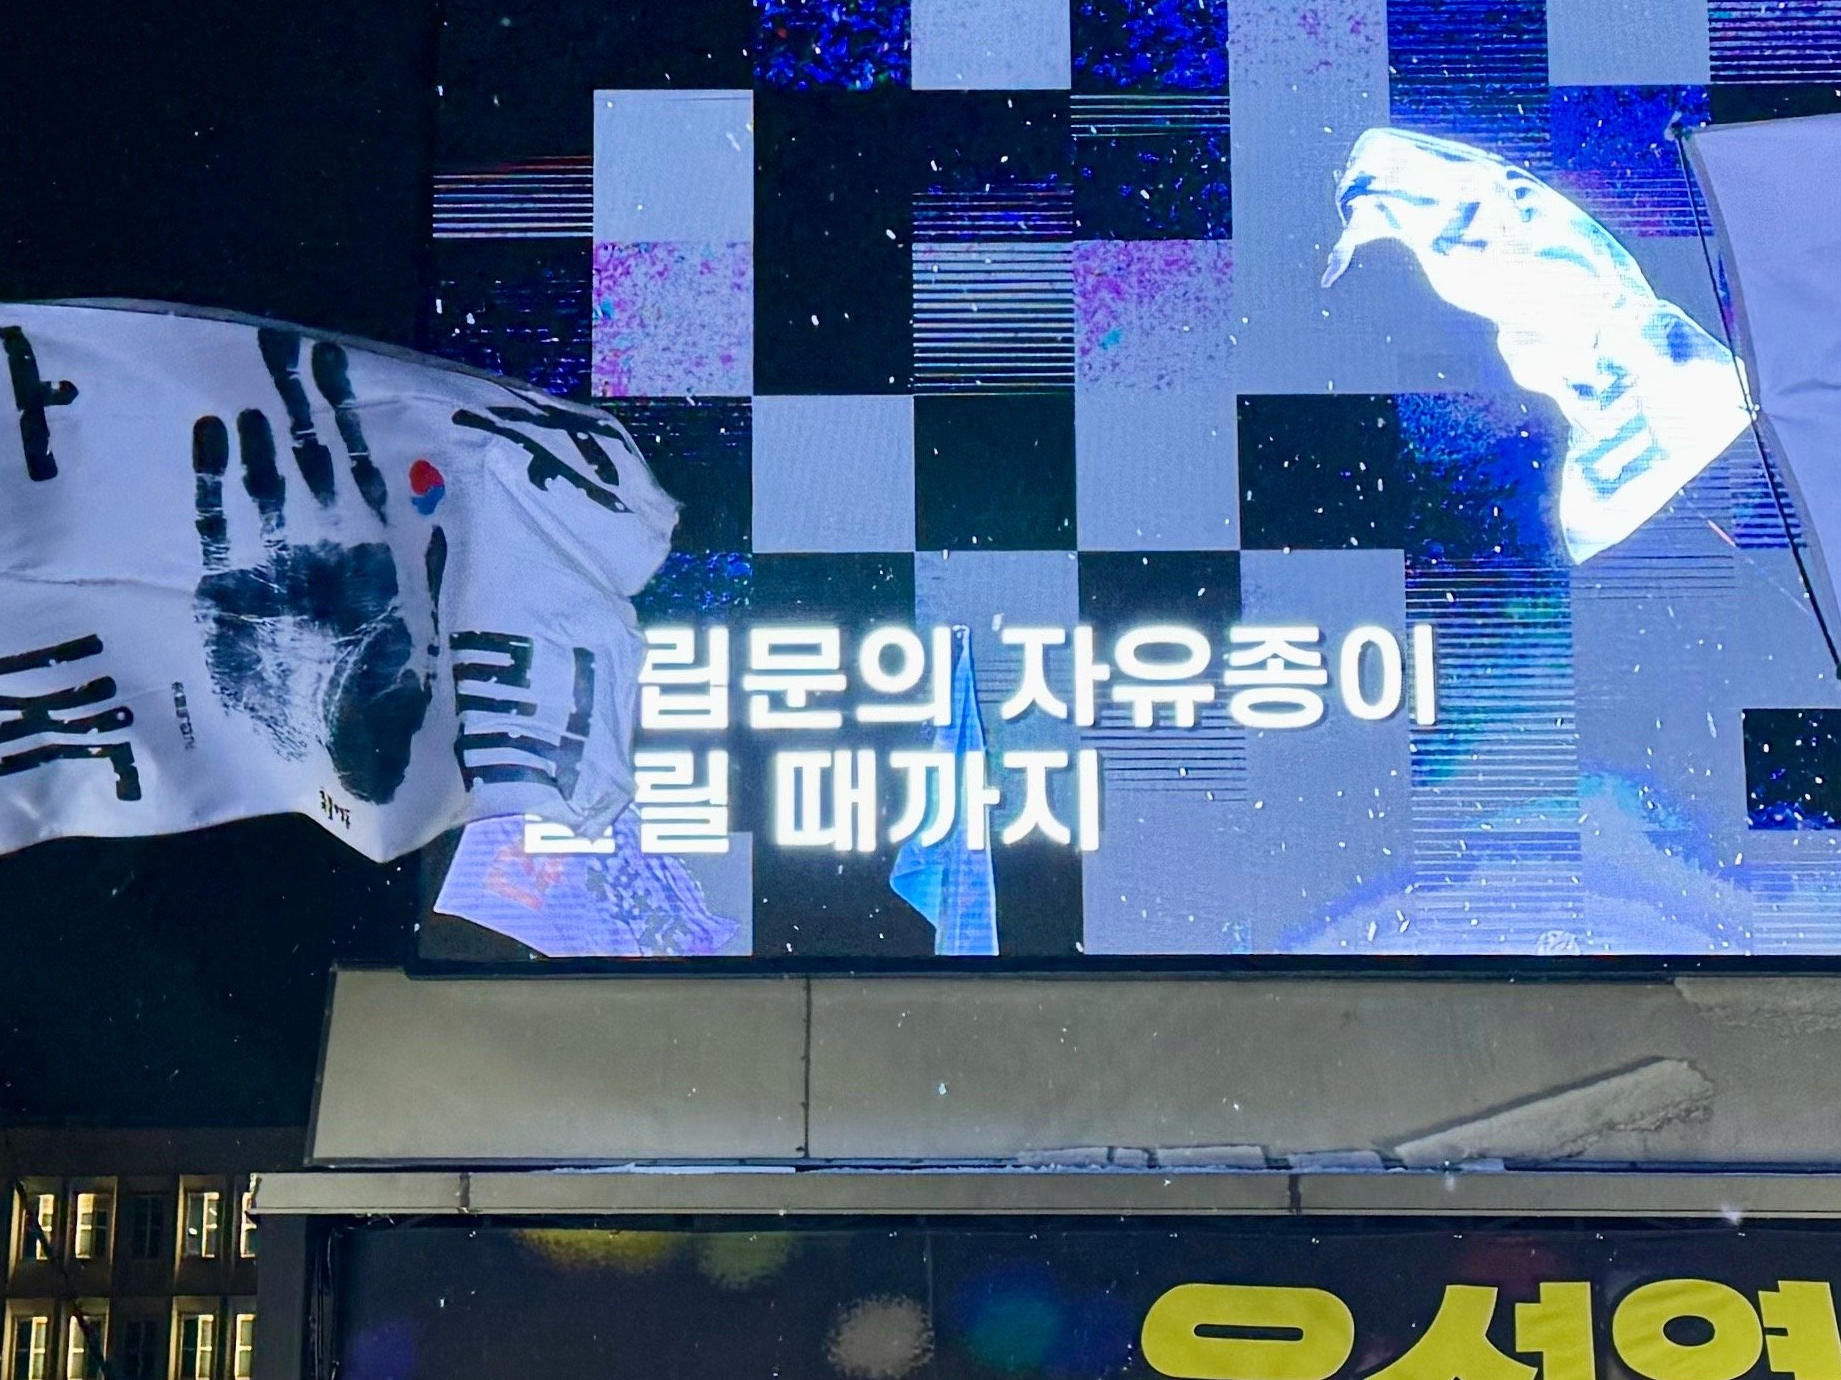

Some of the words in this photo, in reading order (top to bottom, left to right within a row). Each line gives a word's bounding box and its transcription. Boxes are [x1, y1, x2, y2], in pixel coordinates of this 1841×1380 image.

[448, 629, 597, 800] 립
[640, 628, 951, 729] 립문의
[1002, 625, 1435, 728] 자유종이
[777, 751, 1099, 852] 때까지
